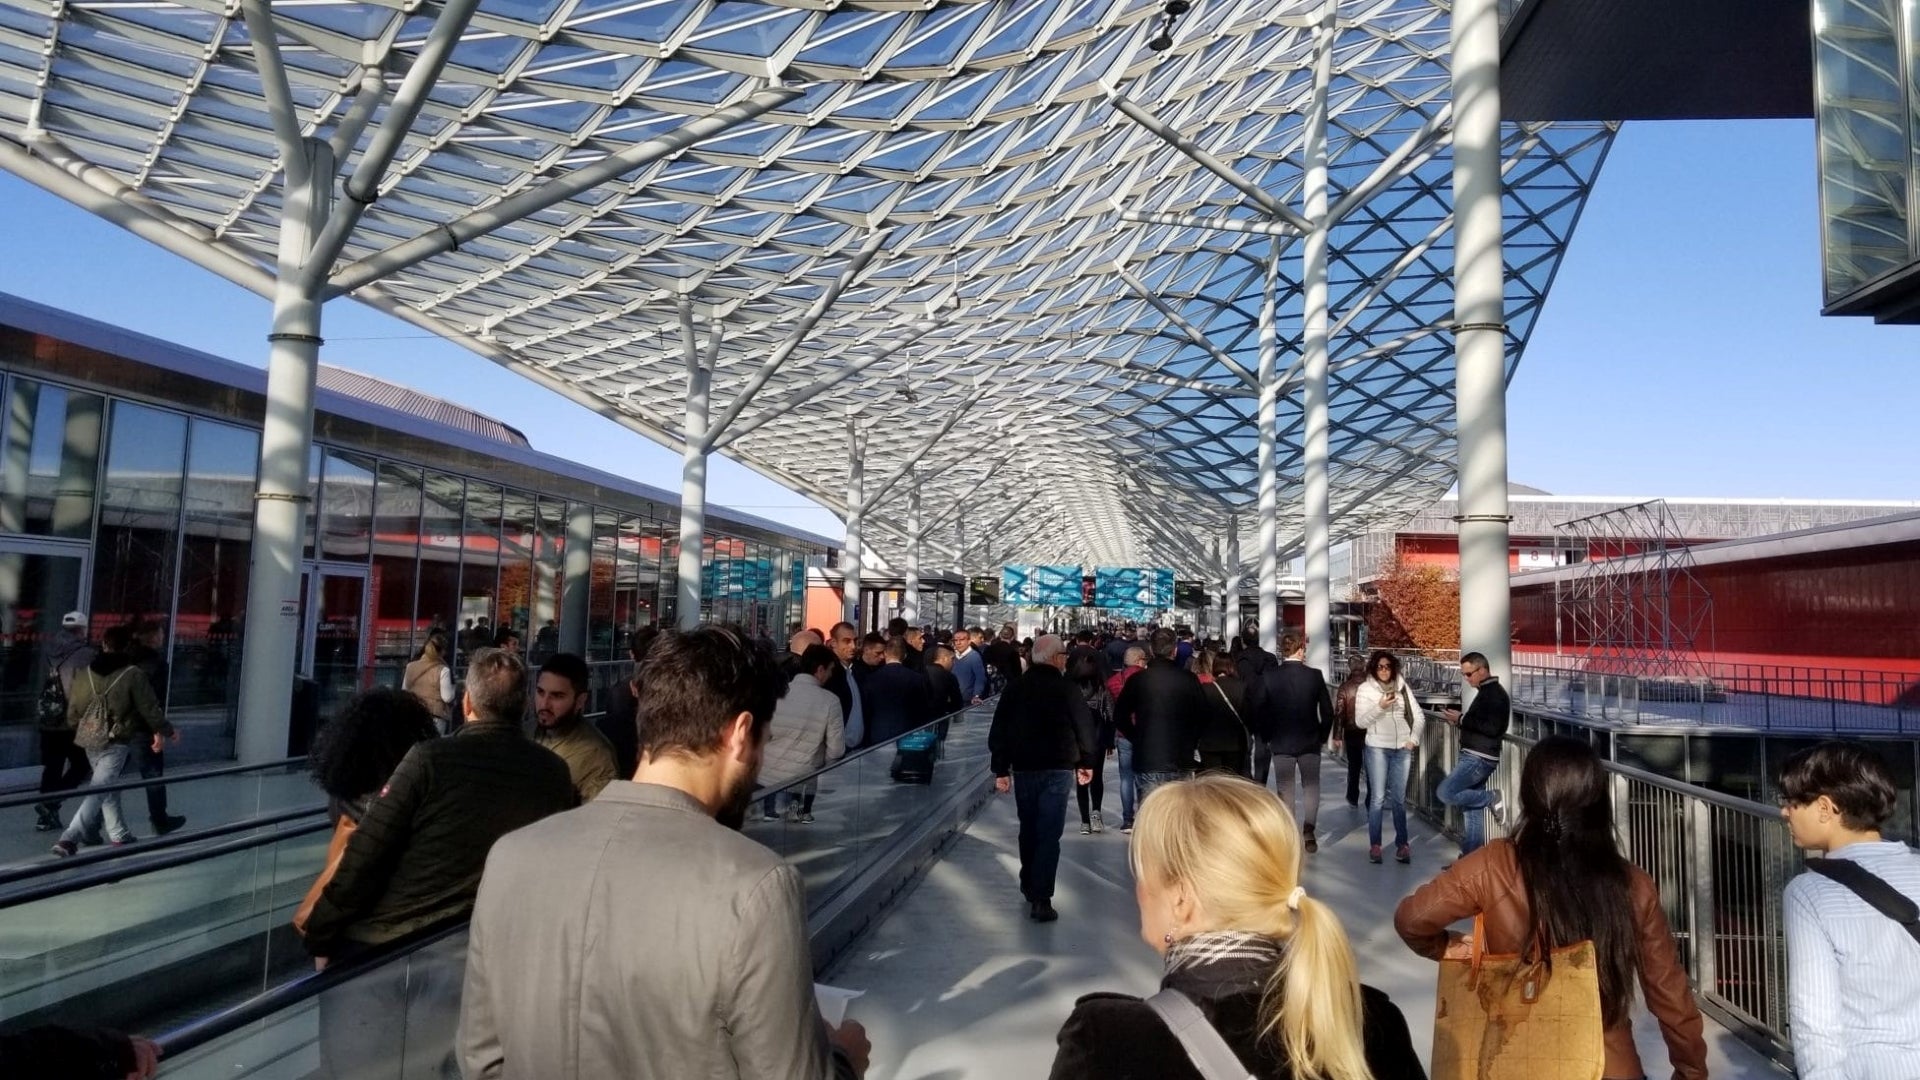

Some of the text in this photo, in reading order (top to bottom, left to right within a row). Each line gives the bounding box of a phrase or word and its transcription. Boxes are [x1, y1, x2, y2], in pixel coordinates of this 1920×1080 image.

[1531, 550, 1538, 561] 8
[1019, 584, 1032, 602] 3
[1136, 587, 1150, 605] 4
